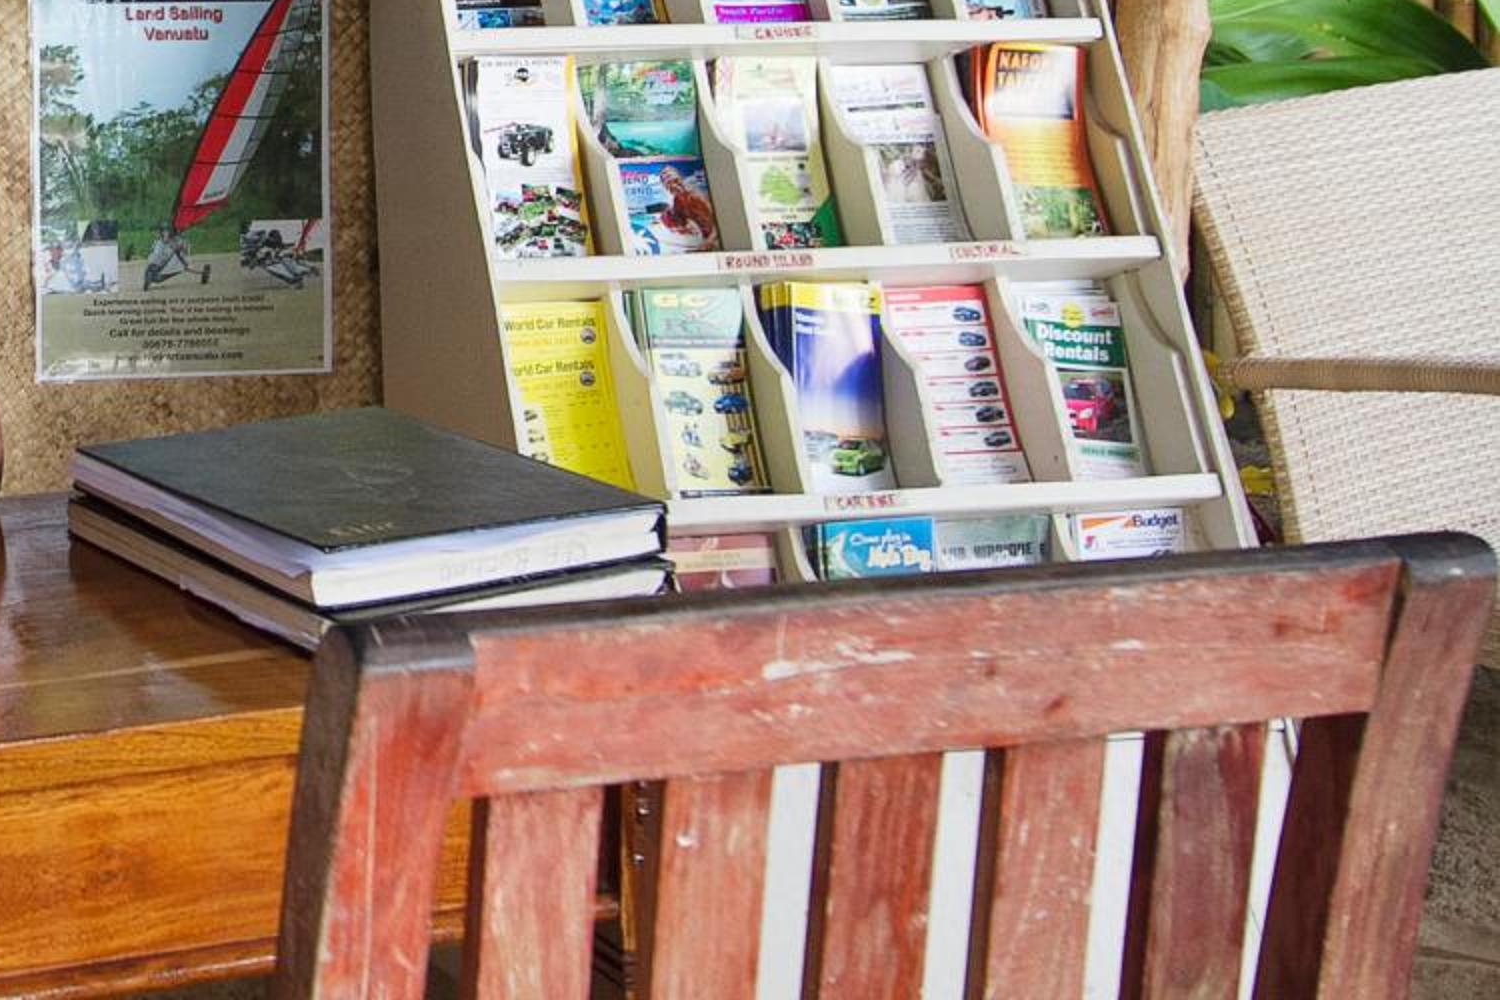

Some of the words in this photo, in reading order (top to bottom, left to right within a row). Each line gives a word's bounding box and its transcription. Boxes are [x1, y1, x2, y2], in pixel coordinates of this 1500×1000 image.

[125, 7, 165, 21] Land
[168, 6, 224, 24] Sailing
[144, 27, 210, 42] Vanuatu
[503, 319, 535, 332] World
[535, 317, 555, 330] Car
[557, 314, 597, 329] Rentals
[1035, 322, 1114, 345] Discount
[1043, 340, 1111, 363] Rentals
[1130, 514, 1180, 530] Budget
